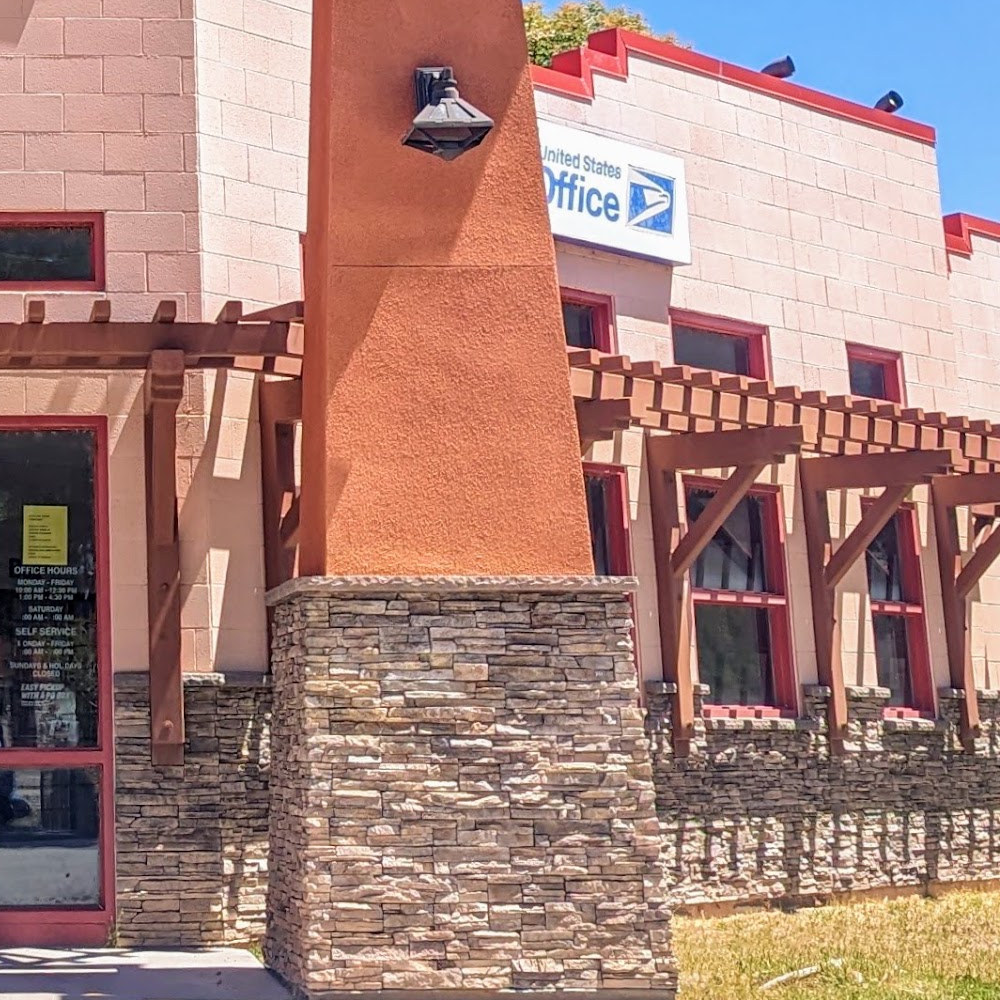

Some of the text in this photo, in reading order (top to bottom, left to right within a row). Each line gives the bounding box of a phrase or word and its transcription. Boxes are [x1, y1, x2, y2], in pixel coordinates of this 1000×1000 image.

[583, 155, 622, 179] States
[542, 166, 620, 222] Office
[14, 566, 78, 575] OFFICE HOURS
[16, 627, 76, 636] SELF SERVICE
